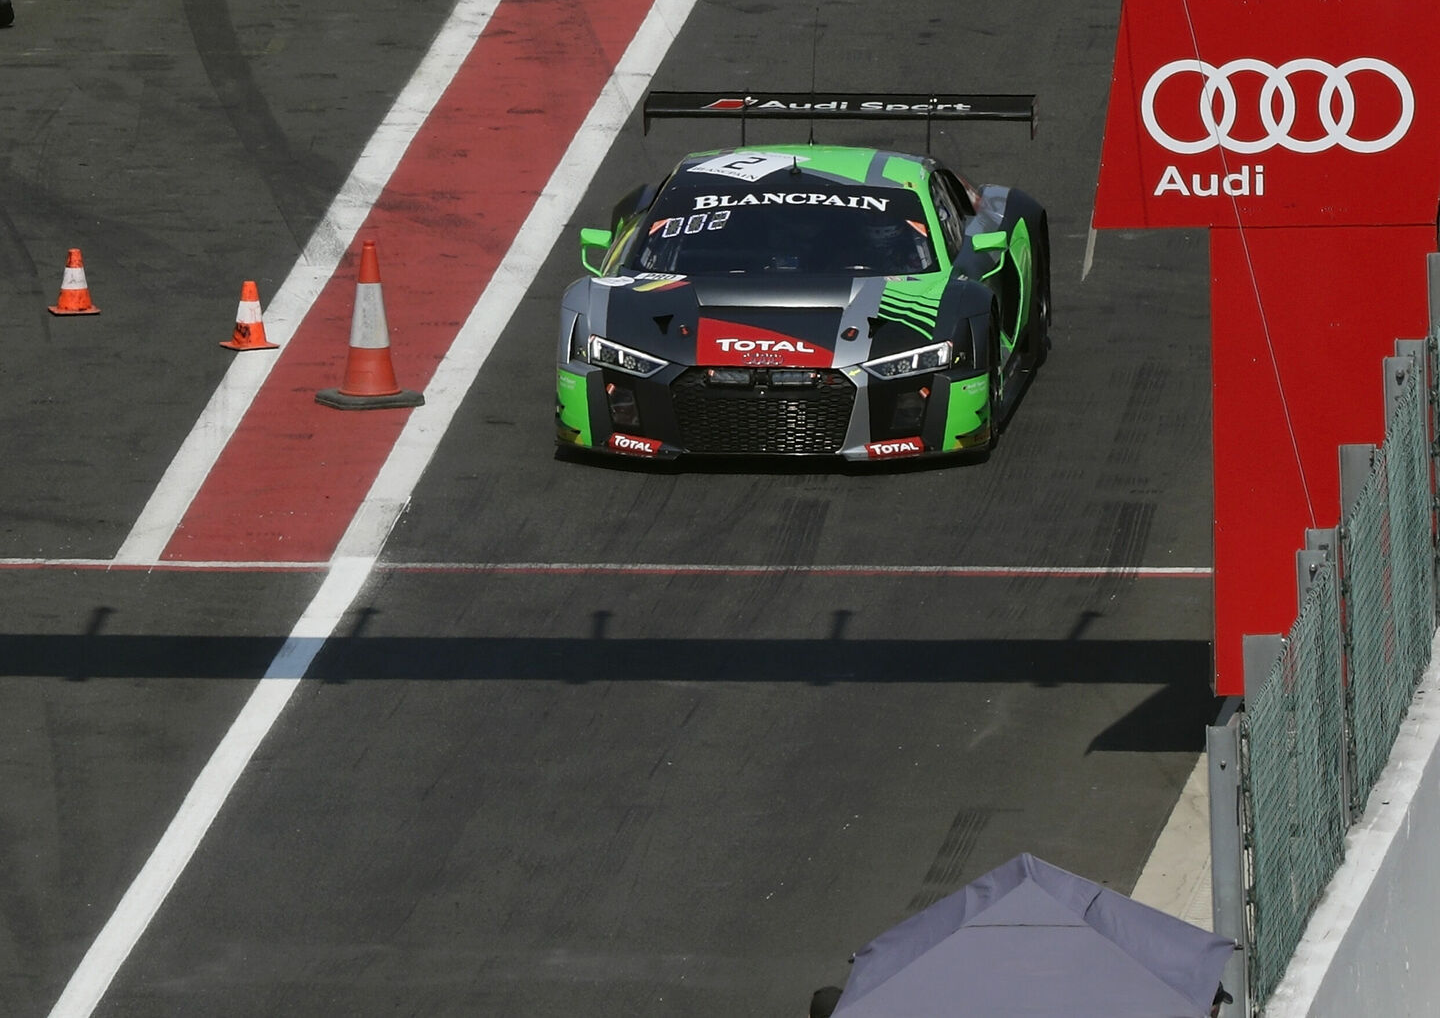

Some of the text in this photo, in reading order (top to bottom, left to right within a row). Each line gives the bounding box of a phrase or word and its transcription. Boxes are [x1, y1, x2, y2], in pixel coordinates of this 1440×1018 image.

[757, 99, 972, 112] Audi Sport
[723, 156, 768, 171] 2
[1153, 165, 1265, 197] Audi
[692, 192, 890, 213] BLANCPAIN
[661, 210, 731, 239] 002
[715, 337, 815, 354] TOTAL
[614, 435, 653, 453] TOTAL
[870, 442, 920, 456] TOTAL
